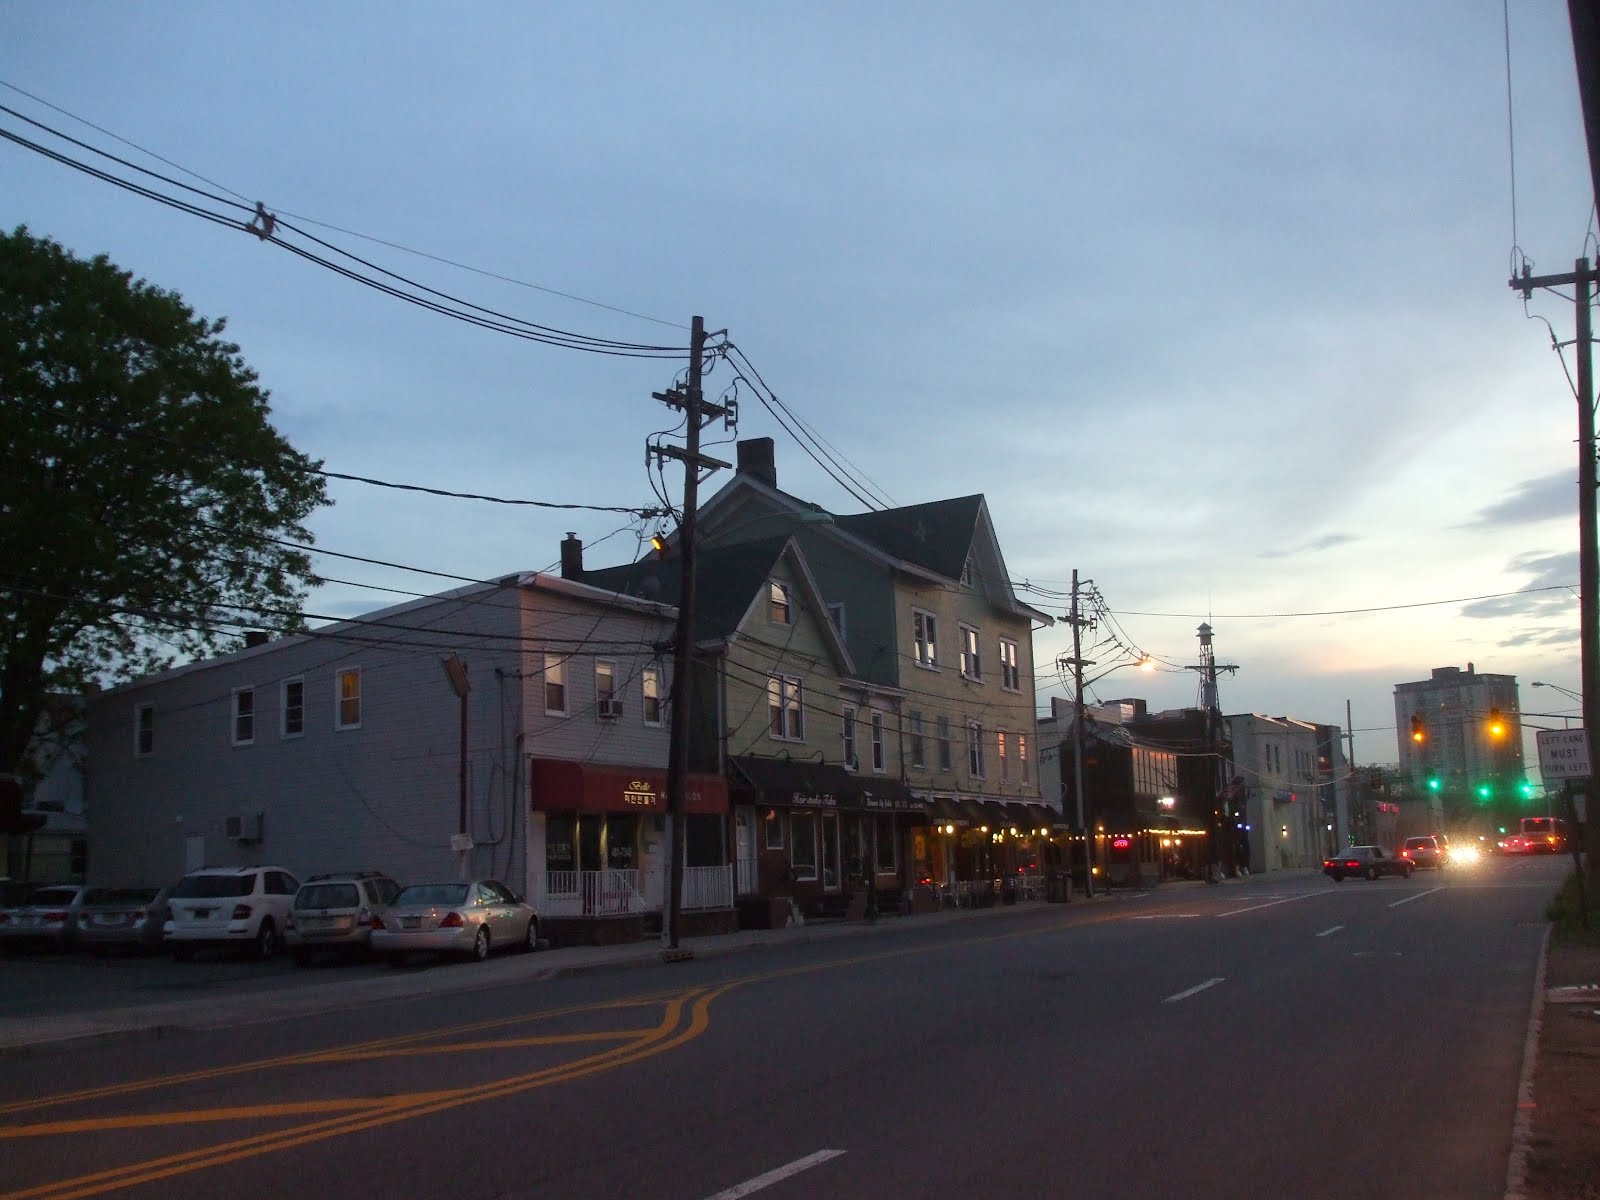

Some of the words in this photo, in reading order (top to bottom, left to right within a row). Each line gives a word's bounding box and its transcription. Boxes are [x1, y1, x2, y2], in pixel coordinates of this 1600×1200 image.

[1542, 736, 1560, 745] LEFT
[1563, 734, 1584, 744] LANE
[1551, 748, 1577, 759] MUST
[1544, 764, 1565, 773] TURN
[1569, 762, 1588, 772] LEFT
